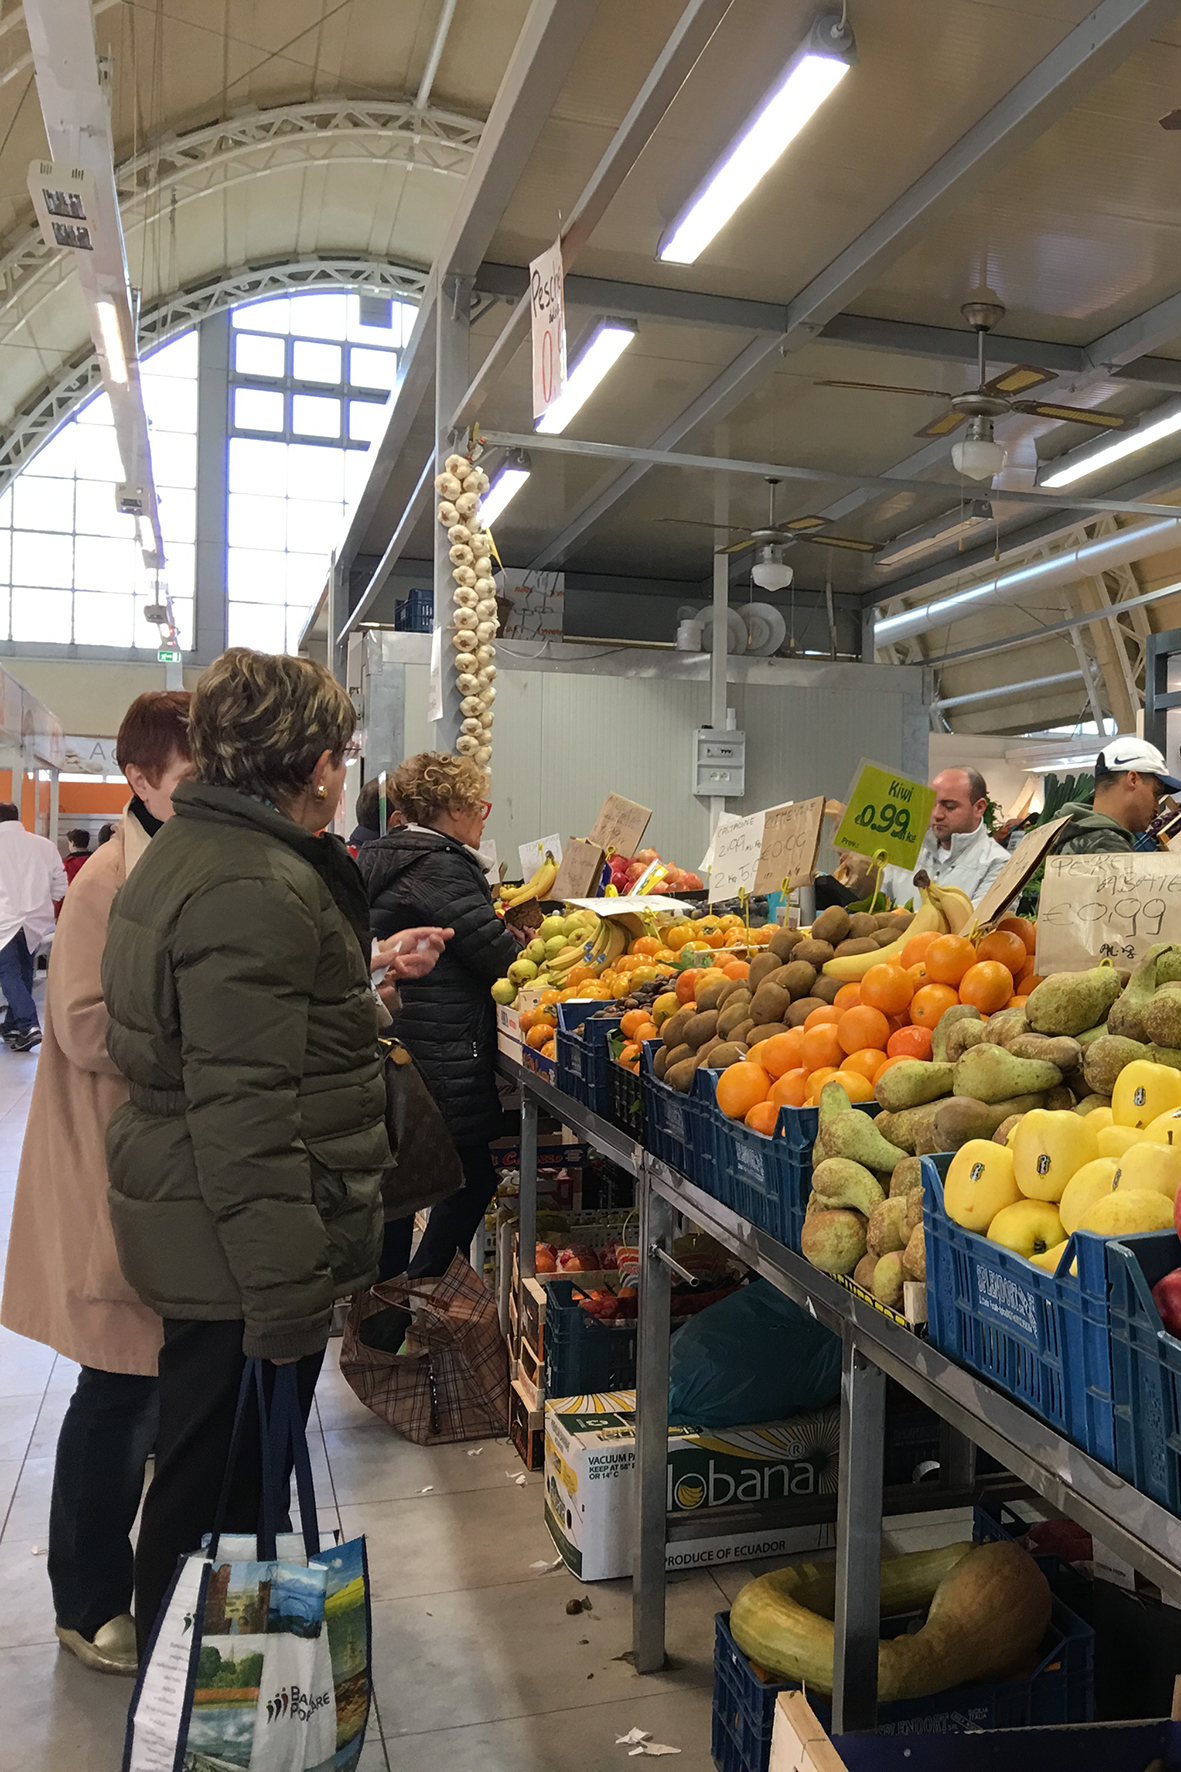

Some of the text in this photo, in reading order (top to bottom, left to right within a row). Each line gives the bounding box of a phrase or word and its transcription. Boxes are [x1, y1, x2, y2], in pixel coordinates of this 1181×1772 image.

[888, 780, 915, 803] Kiwi
[588, 1453, 626, 1466] VACUUM
[589, 1465, 610, 1473] KEEP
[610, 1464, 620, 1472] AT
[667, 1459, 815, 1511] lobana
[716, 1547, 732, 1560] OF
[734, 1541, 786, 1558] ECUADOR
